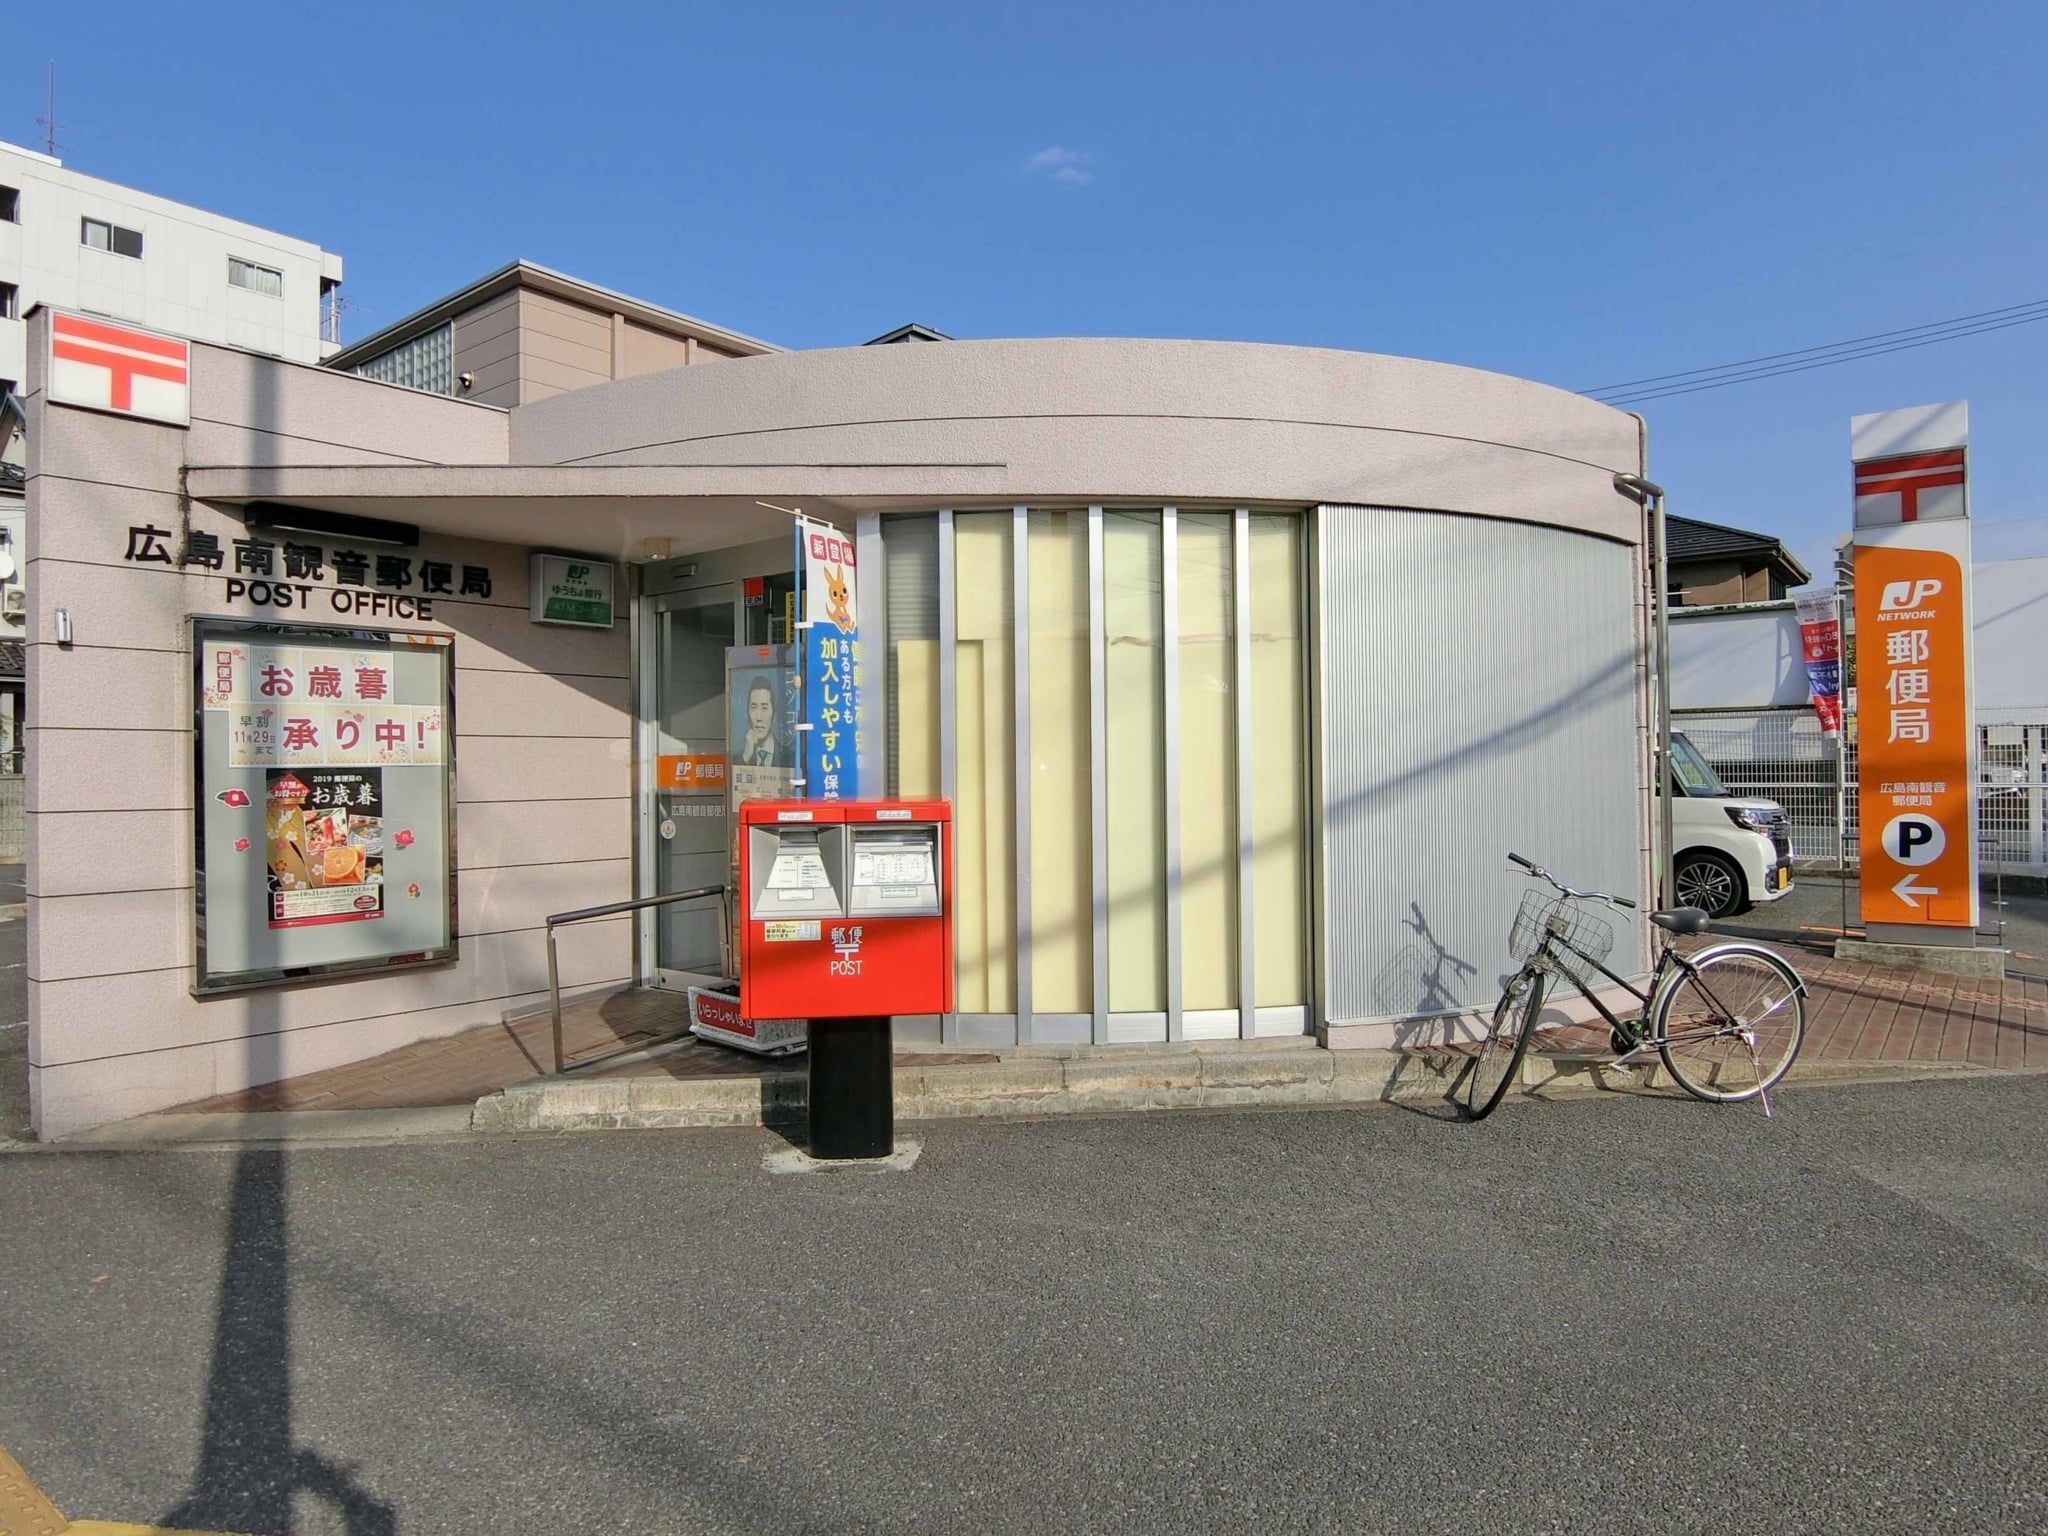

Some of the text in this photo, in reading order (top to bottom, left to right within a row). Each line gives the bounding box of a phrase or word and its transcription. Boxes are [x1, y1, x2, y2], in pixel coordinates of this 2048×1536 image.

[812, 538, 856, 564] 新登場
[124, 524, 493, 599] 広島南観音郵便局
[567, 565, 590, 579] JP
[226, 578, 434, 622] POST OFFICE
[1879, 579, 1943, 611] JP
[1876, 610, 1936, 622] NETWORK
[260, 665, 388, 700] お歳暮
[840, 640, 854, 724] ある方でも
[1885, 629, 1931, 744] 郵便局
[240, 715, 269, 728] 早割
[234, 730, 276, 744] 11月29日
[254, 746, 274, 755] まで
[313, 775, 332, 783] 2019
[695, 764, 724, 778] 郵便局
[312, 782, 378, 806] お歳暮
[1880, 782, 1946, 793] 広島南観音
[1892, 795, 1932, 806] 郵便局
[1899, 821, 1932, 858] P
[831, 927, 863, 944] 郵便
[830, 960, 862, 976] POST
